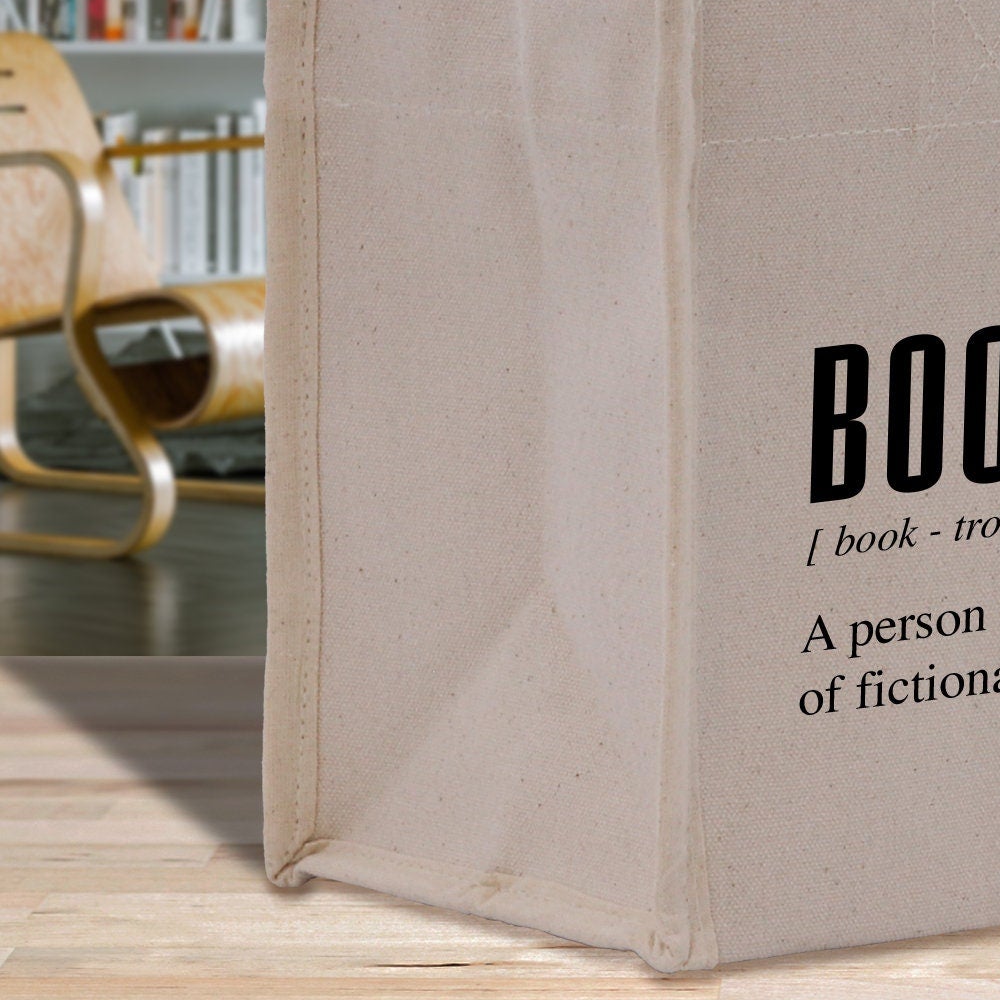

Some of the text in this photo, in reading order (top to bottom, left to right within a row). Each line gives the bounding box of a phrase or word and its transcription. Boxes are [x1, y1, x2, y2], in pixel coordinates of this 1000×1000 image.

[833, 516, 919, 557] book
[800, 614, 837, 654] A
[848, 604, 987, 660] person
[798, 674, 846, 717] of
